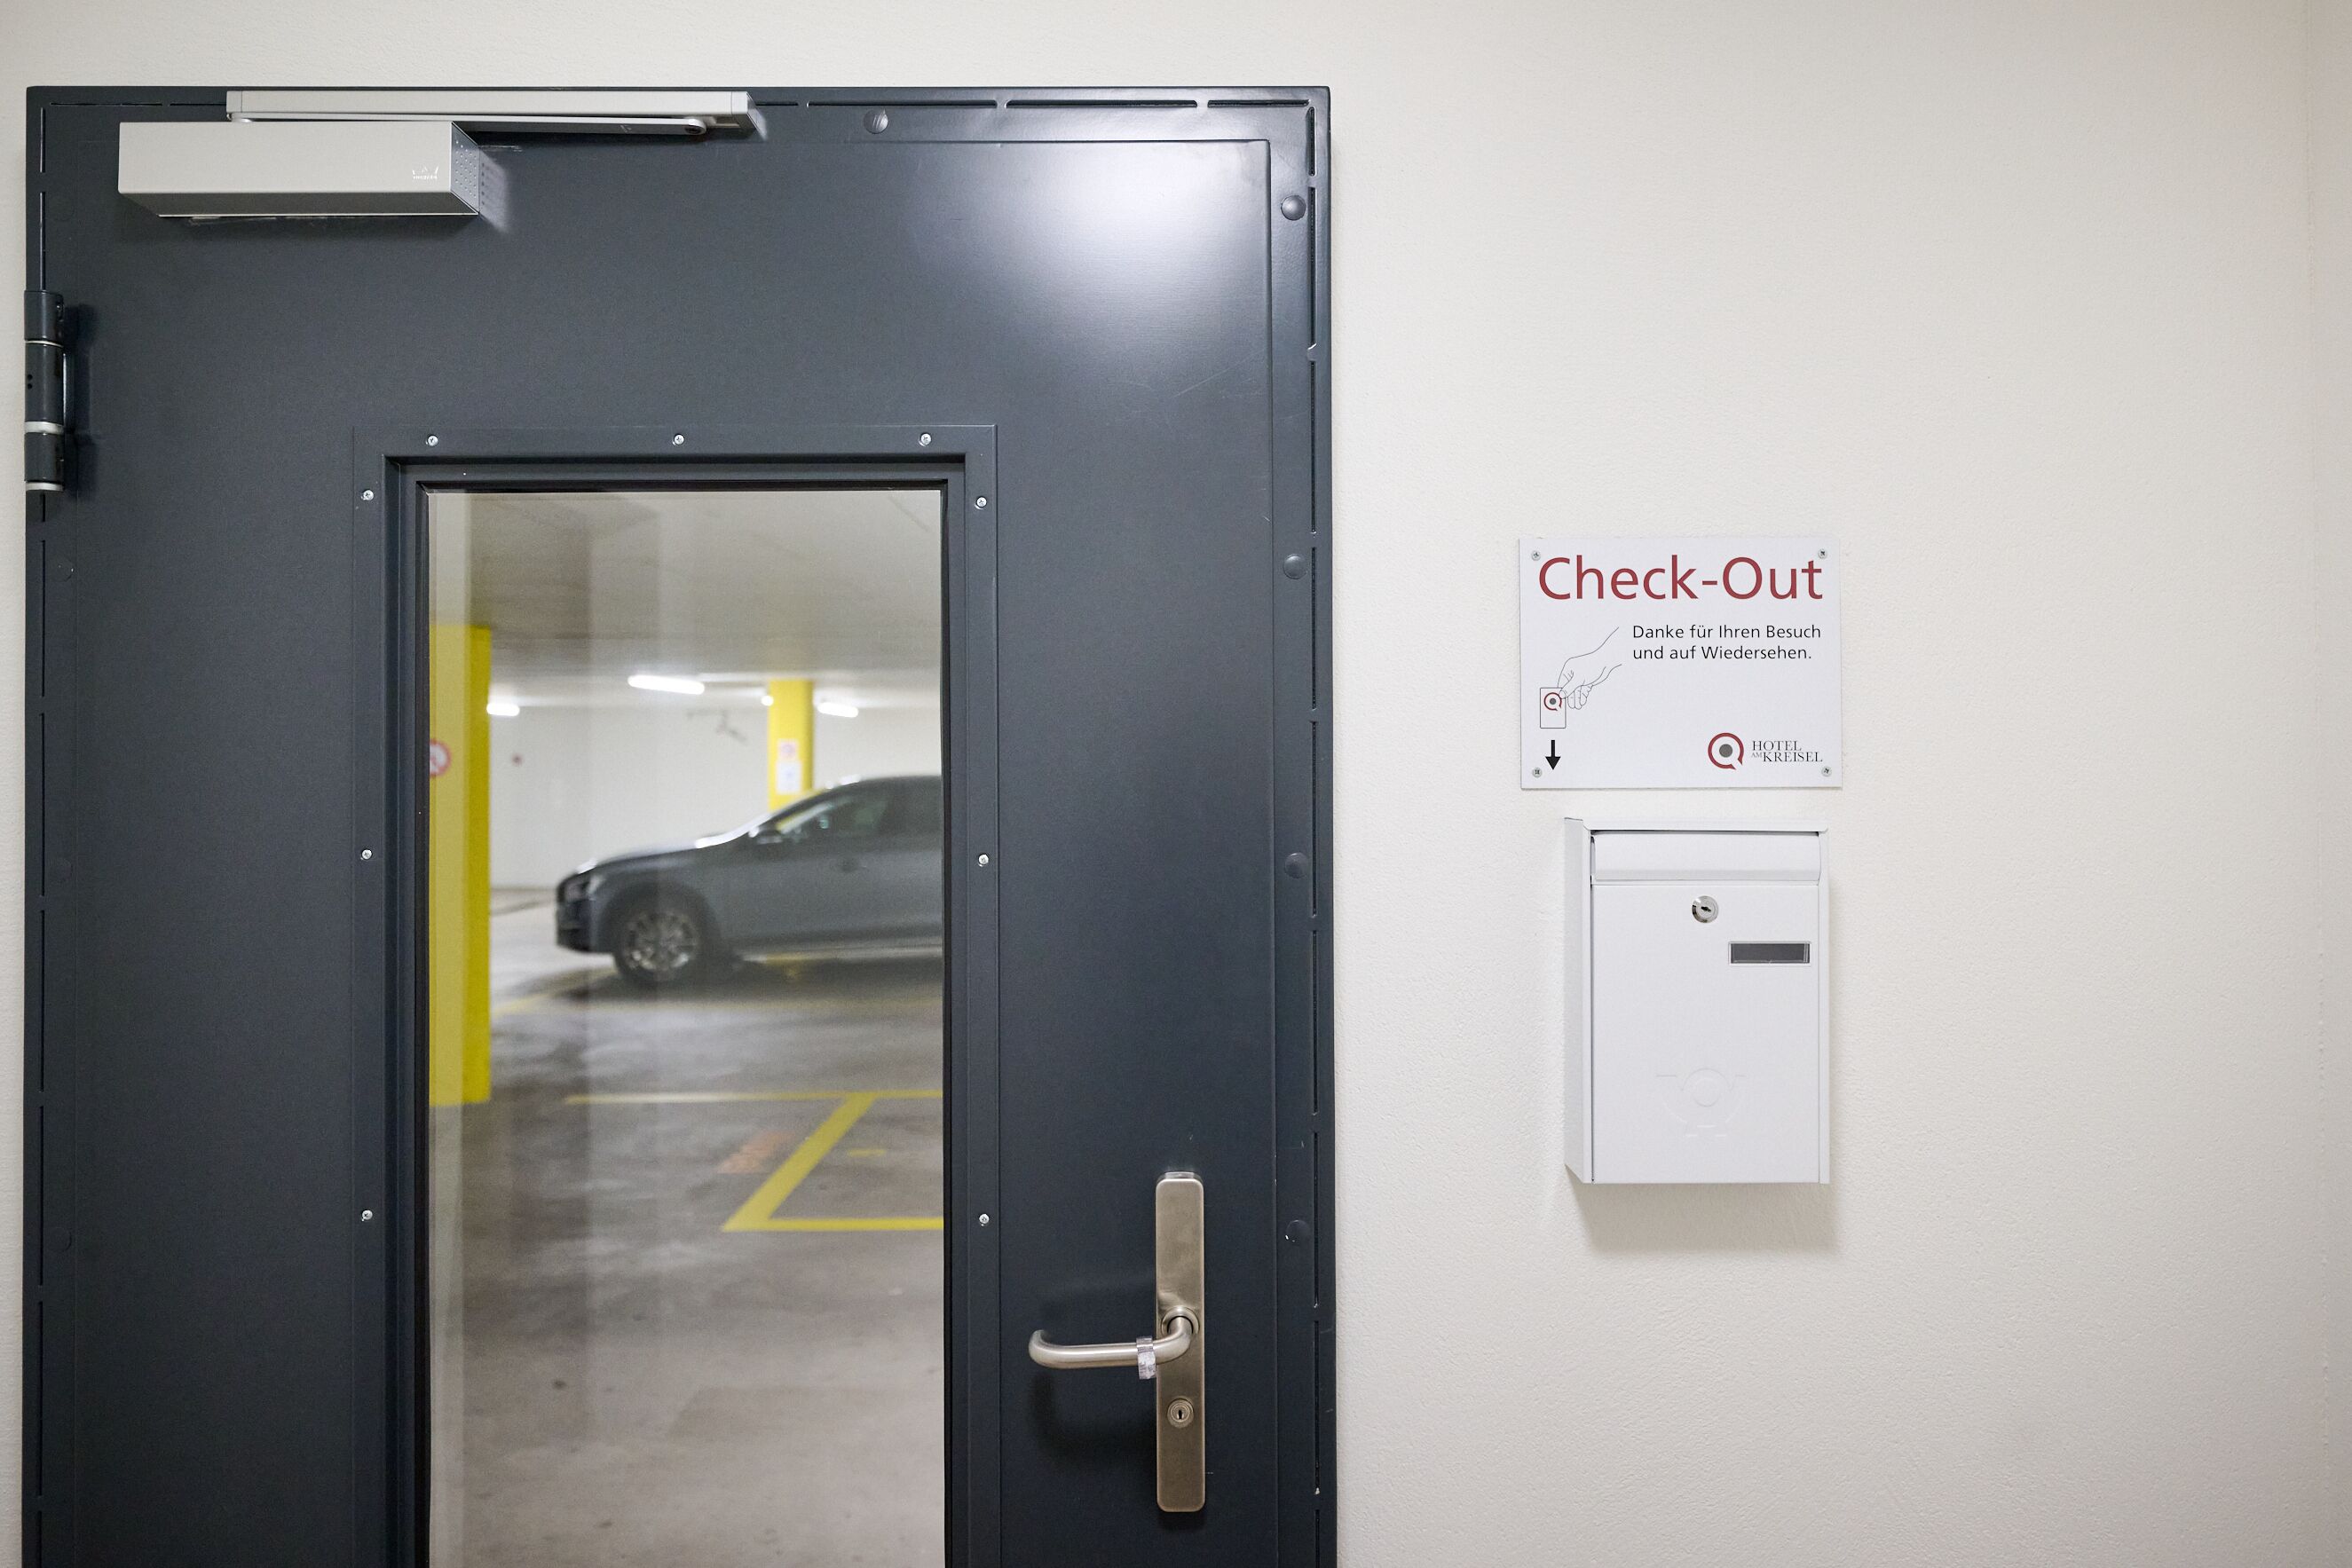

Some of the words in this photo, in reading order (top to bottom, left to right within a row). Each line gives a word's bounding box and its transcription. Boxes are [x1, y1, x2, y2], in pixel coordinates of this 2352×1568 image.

[1538, 554, 1824, 600] Check-Out
[1632, 625, 1685, 639] Danke
[1689, 624, 1714, 639] für
[1718, 624, 1761, 639] Ihren
[1765, 624, 1821, 639] Besuch
[1632, 645, 1664, 660] und
[1669, 644, 1697, 660] auf
[1701, 644, 1812, 660] Wiedersehen.
[1751, 740, 1803, 752] HOTEL
[1763, 751, 1823, 762] KREISEL
